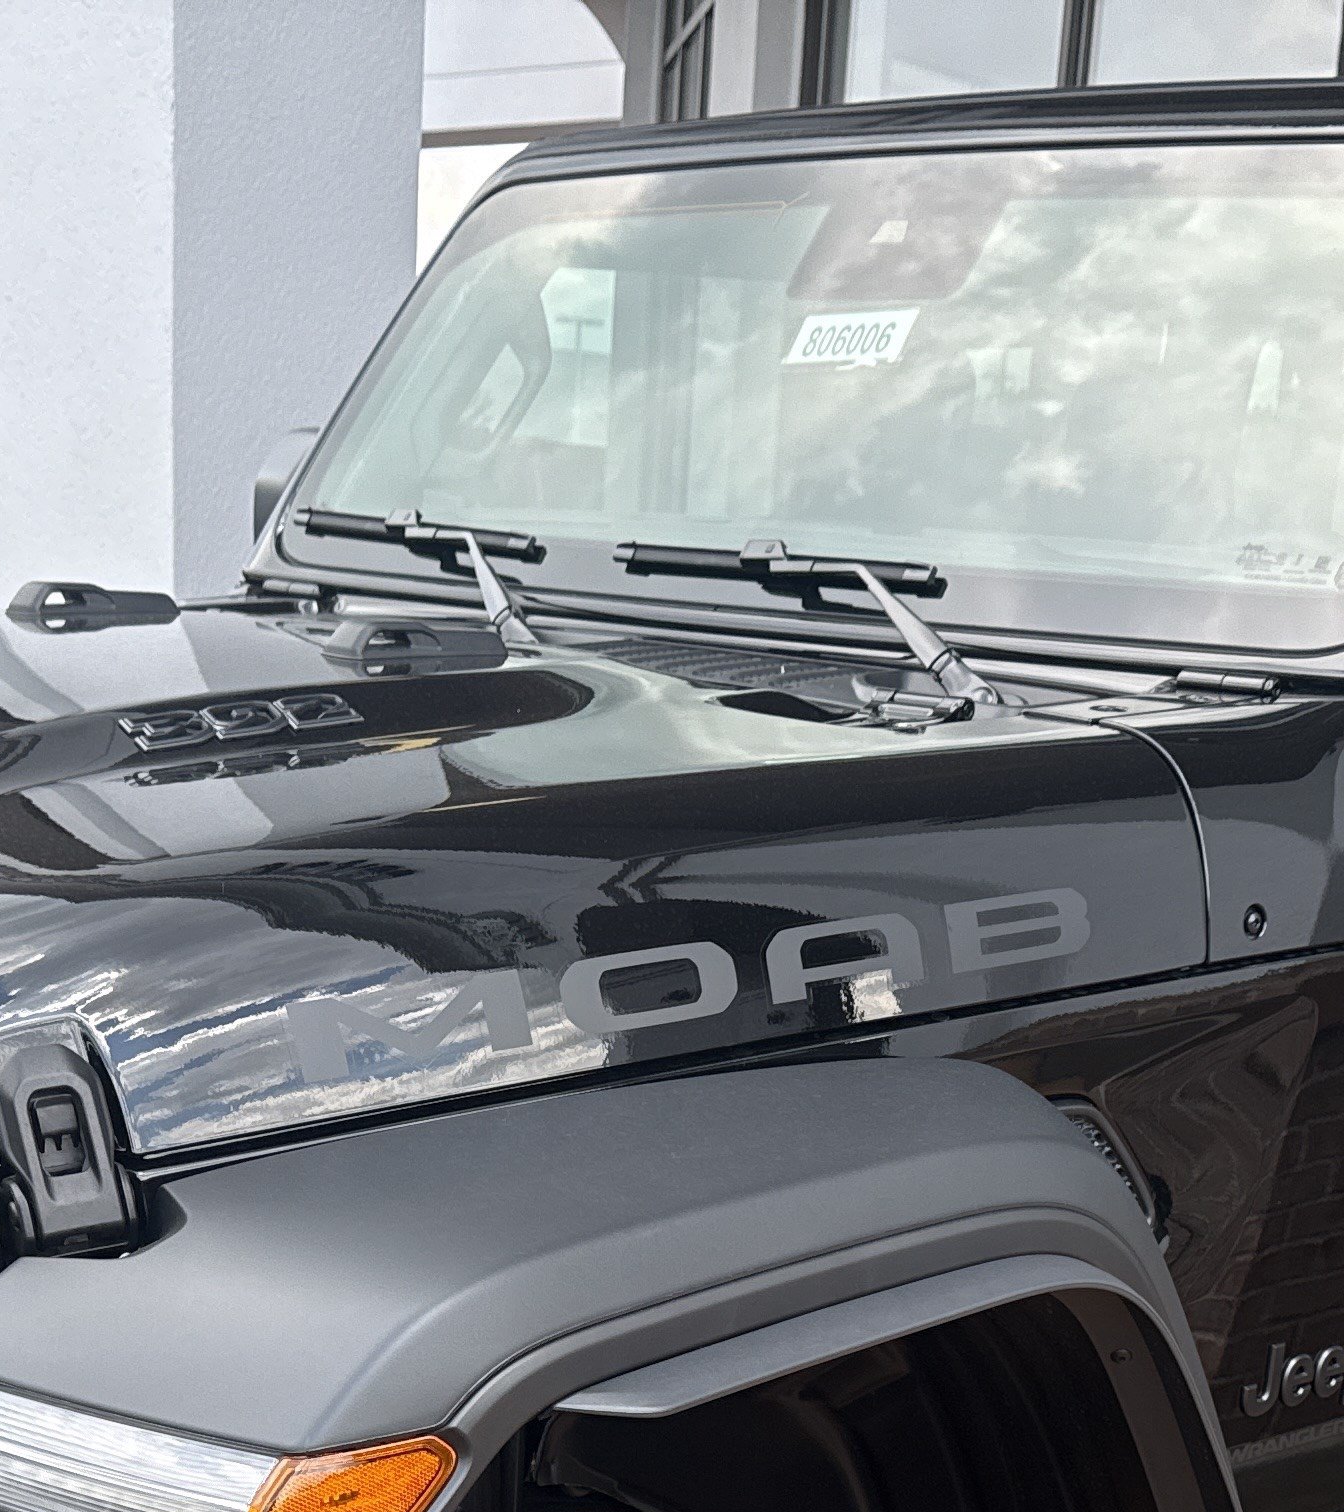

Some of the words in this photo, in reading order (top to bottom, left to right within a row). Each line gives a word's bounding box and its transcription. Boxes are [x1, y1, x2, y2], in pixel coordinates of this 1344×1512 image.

[802, 321, 896, 356] 806006
[118, 693, 364, 751] 392
[288, 887, 1092, 1082] MOAB
